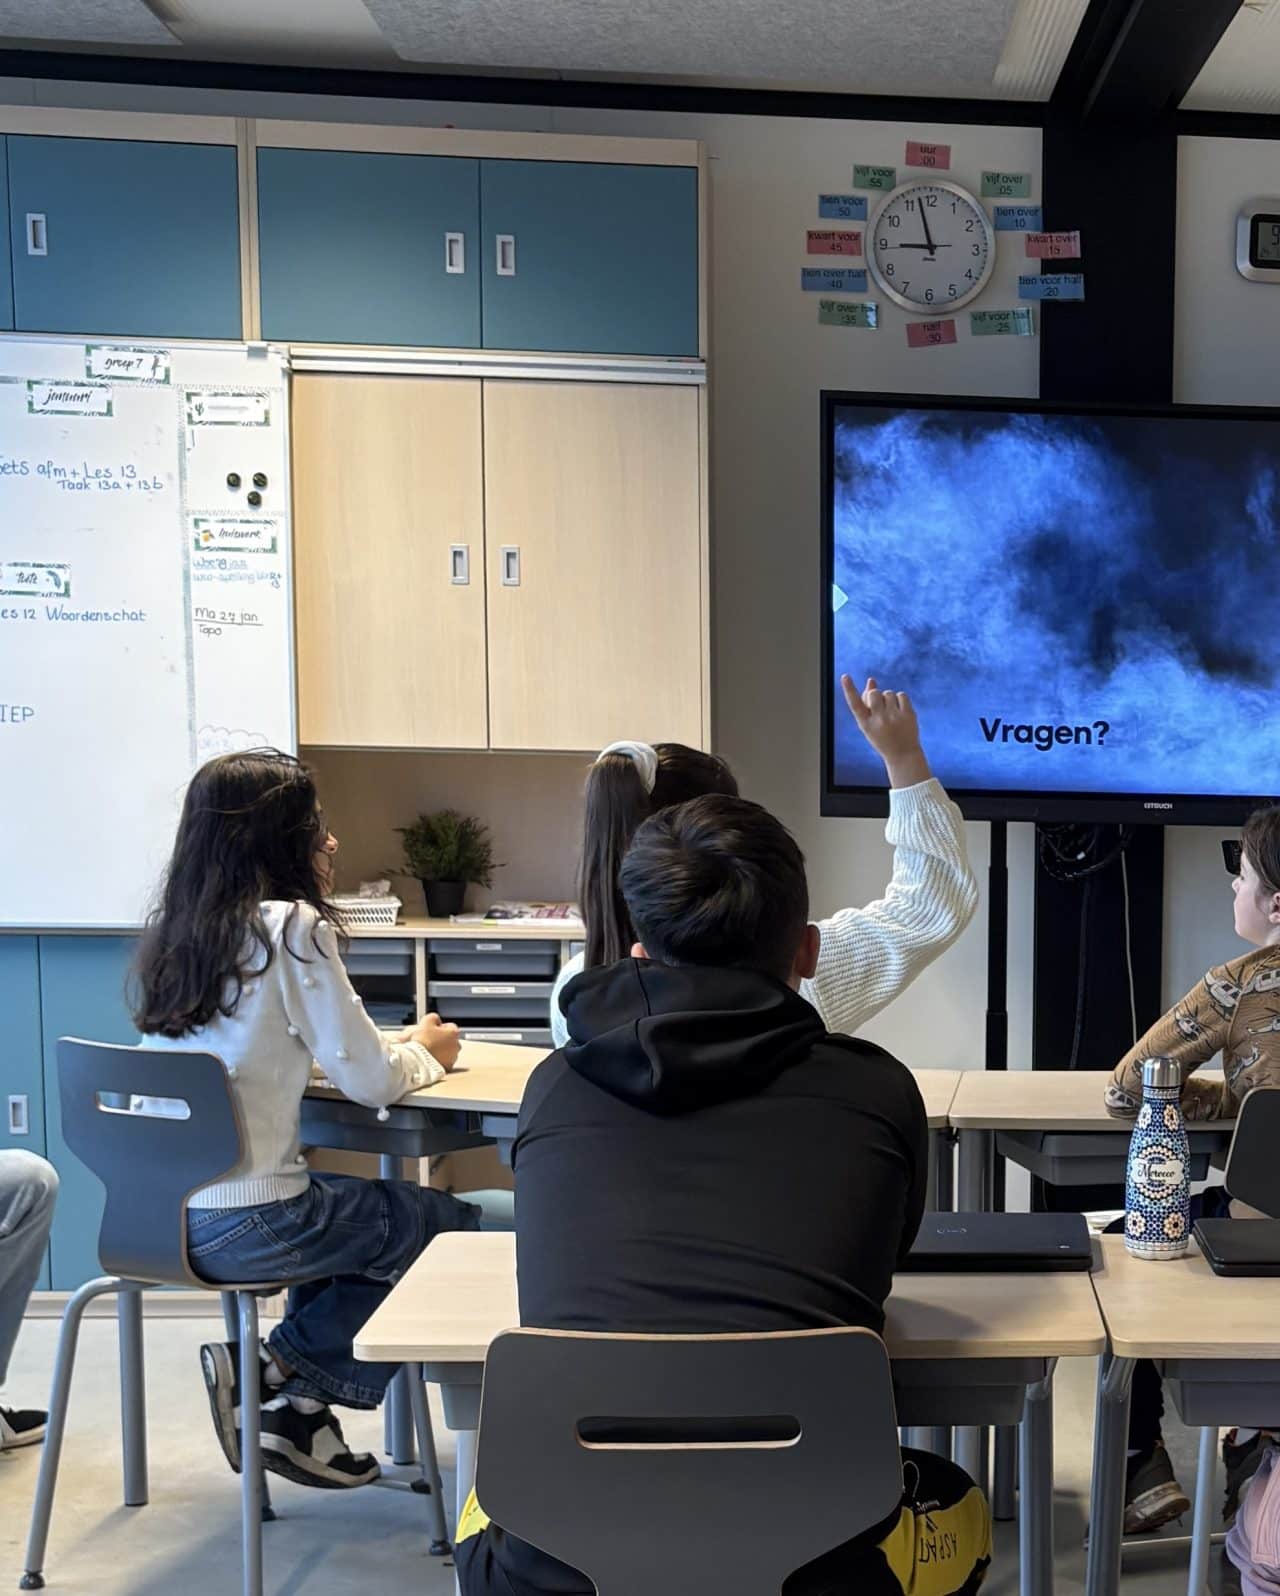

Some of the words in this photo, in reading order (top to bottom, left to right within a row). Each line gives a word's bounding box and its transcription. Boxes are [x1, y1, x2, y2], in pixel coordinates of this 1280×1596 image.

[871, 169, 896, 178] voor
[985, 173, 1000, 184] vijf
[1002, 175, 1023, 184] over
[904, 200, 914, 212] 11
[925, 195, 938, 208] 12
[952, 201, 957, 214] 1
[996, 207, 1014, 217] tien
[1016, 208, 1040, 217] over
[887, 215, 901, 228] 10
[965, 219, 974, 232] 2
[808, 231, 836, 241] kwart
[838, 232, 862, 241] voor
[1027, 233, 1053, 243] kwart
[1055, 233, 1078, 242] over
[879, 237, 888, 250] 9
[972, 243, 980, 256] 3
[822, 270, 845, 278] over
[886, 263, 896, 276] 8
[964, 267, 973, 280] 4
[902, 281, 911, 293] 7
[948, 283, 957, 297] 5
[925, 288, 935, 302] 6
[989, 312, 1011, 321] voor
[104, 358, 134, 371] groep
[83, 461, 113, 479] Les
[121, 464, 137, 478] 13
[56, 477, 91, 491] Taak
[1, 608, 18, 619] es
[24, 608, 37, 620] 12
[46, 603, 147, 622] Woordenschat
[979, 717, 1110, 752] Vragen?
